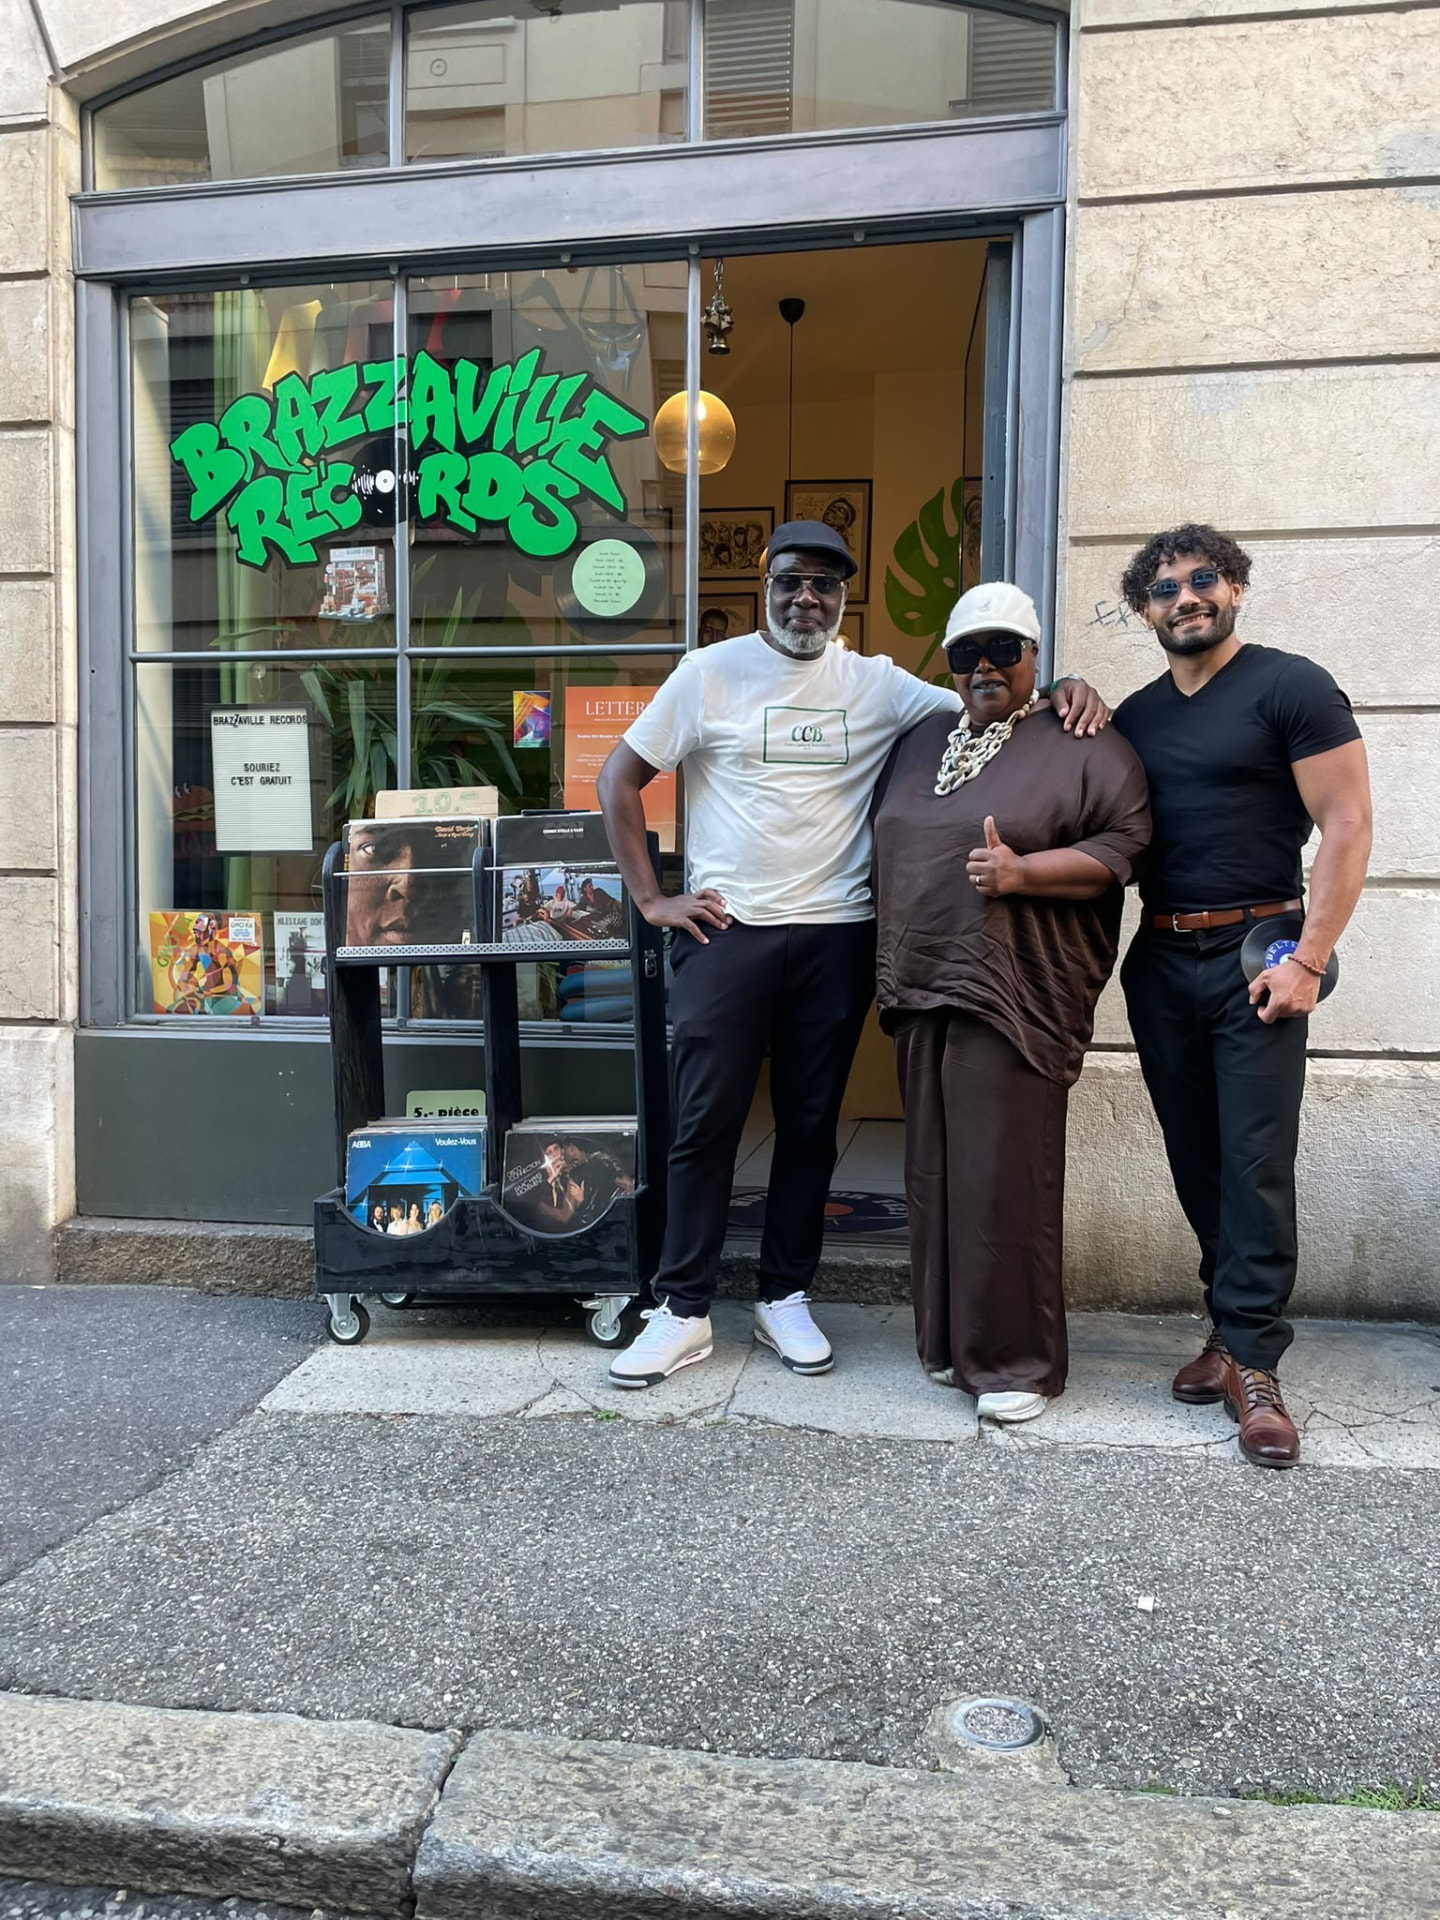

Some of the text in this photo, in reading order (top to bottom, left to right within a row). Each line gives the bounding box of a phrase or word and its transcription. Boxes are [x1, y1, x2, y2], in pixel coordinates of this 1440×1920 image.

[213, 714, 308, 728] BRAZZAVILLE RECORDS
[243, 762, 281, 772] SOURIEZ
[231, 775, 292, 786] C'EST GRATUIT
[438, 1106, 480, 1117] pièce
[351, 1137, 477, 1149] ABBA Voulez-Vous
